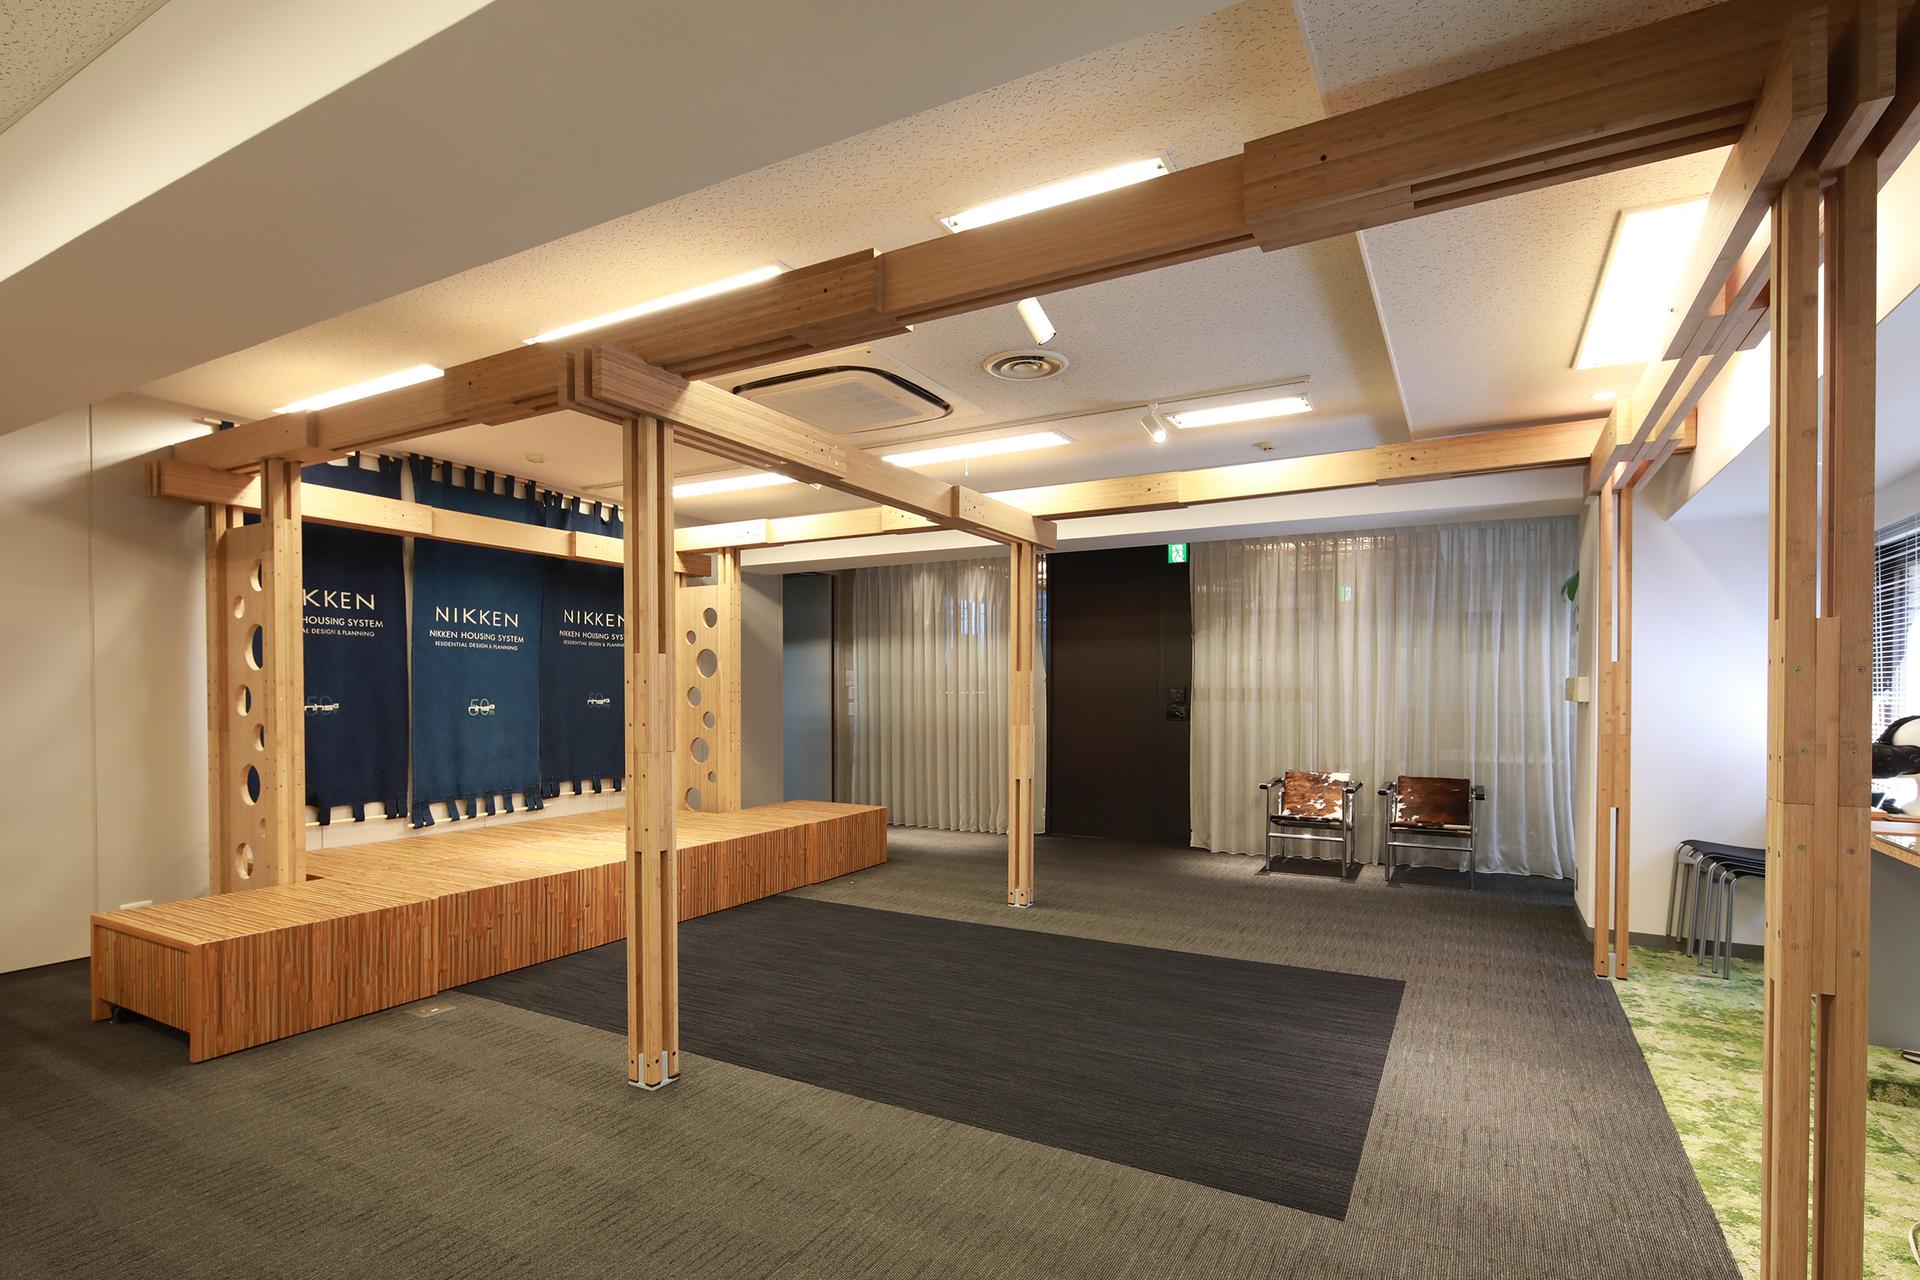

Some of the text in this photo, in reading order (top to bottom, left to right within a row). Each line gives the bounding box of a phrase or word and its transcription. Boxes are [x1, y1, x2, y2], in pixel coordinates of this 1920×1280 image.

[303, 588, 375, 611] KKEN
[435, 606, 519, 628] NIKKEN
[347, 618, 384, 628] SYSTEM
[342, 629, 375, 637] PLANNING
[429, 629, 525, 643] NIKKEN HOUSING SYSTEM
[559, 630, 624, 641] NIKKEN HOUSING SYS
[435, 640, 468, 648] RESIDENTIAL
